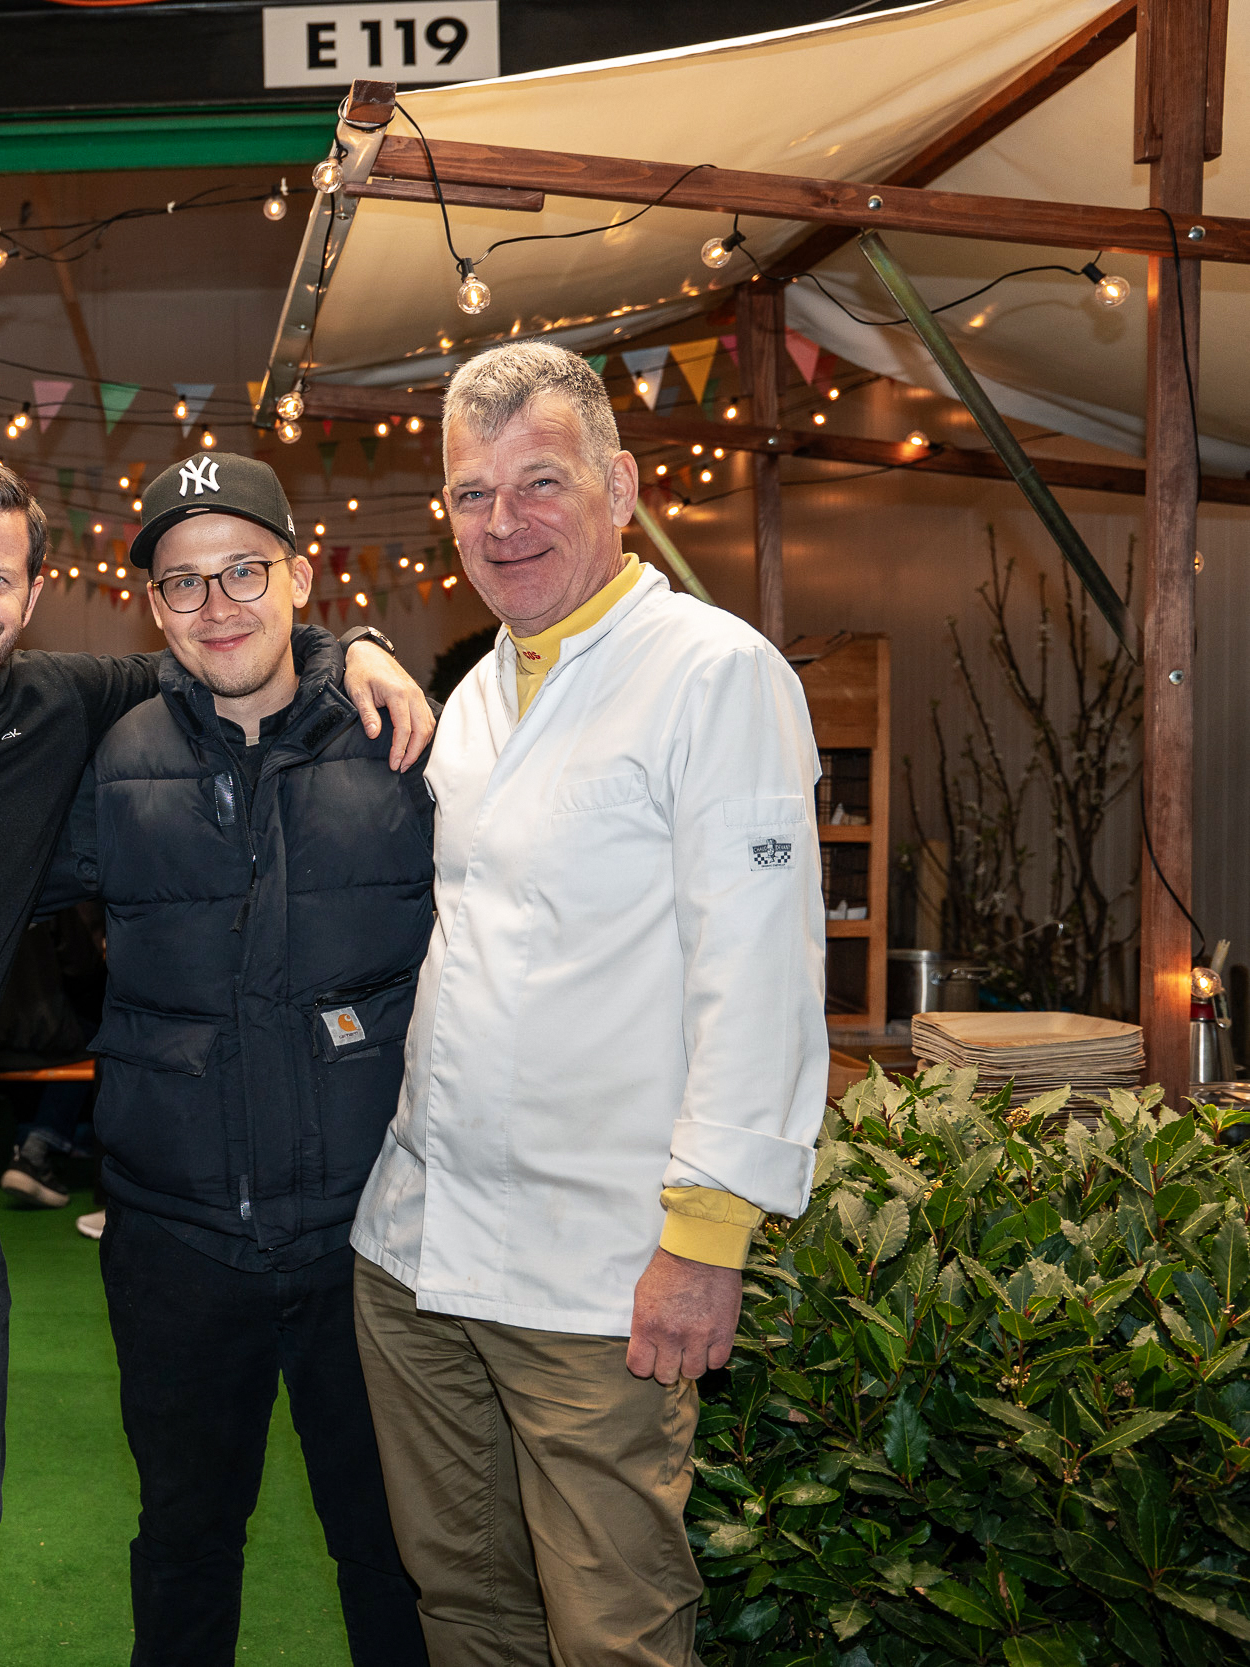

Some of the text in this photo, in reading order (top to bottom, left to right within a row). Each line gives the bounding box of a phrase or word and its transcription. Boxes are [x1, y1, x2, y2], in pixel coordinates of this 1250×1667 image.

[307, 17, 469, 69] E 119
[179, 456, 221, 497] NY
